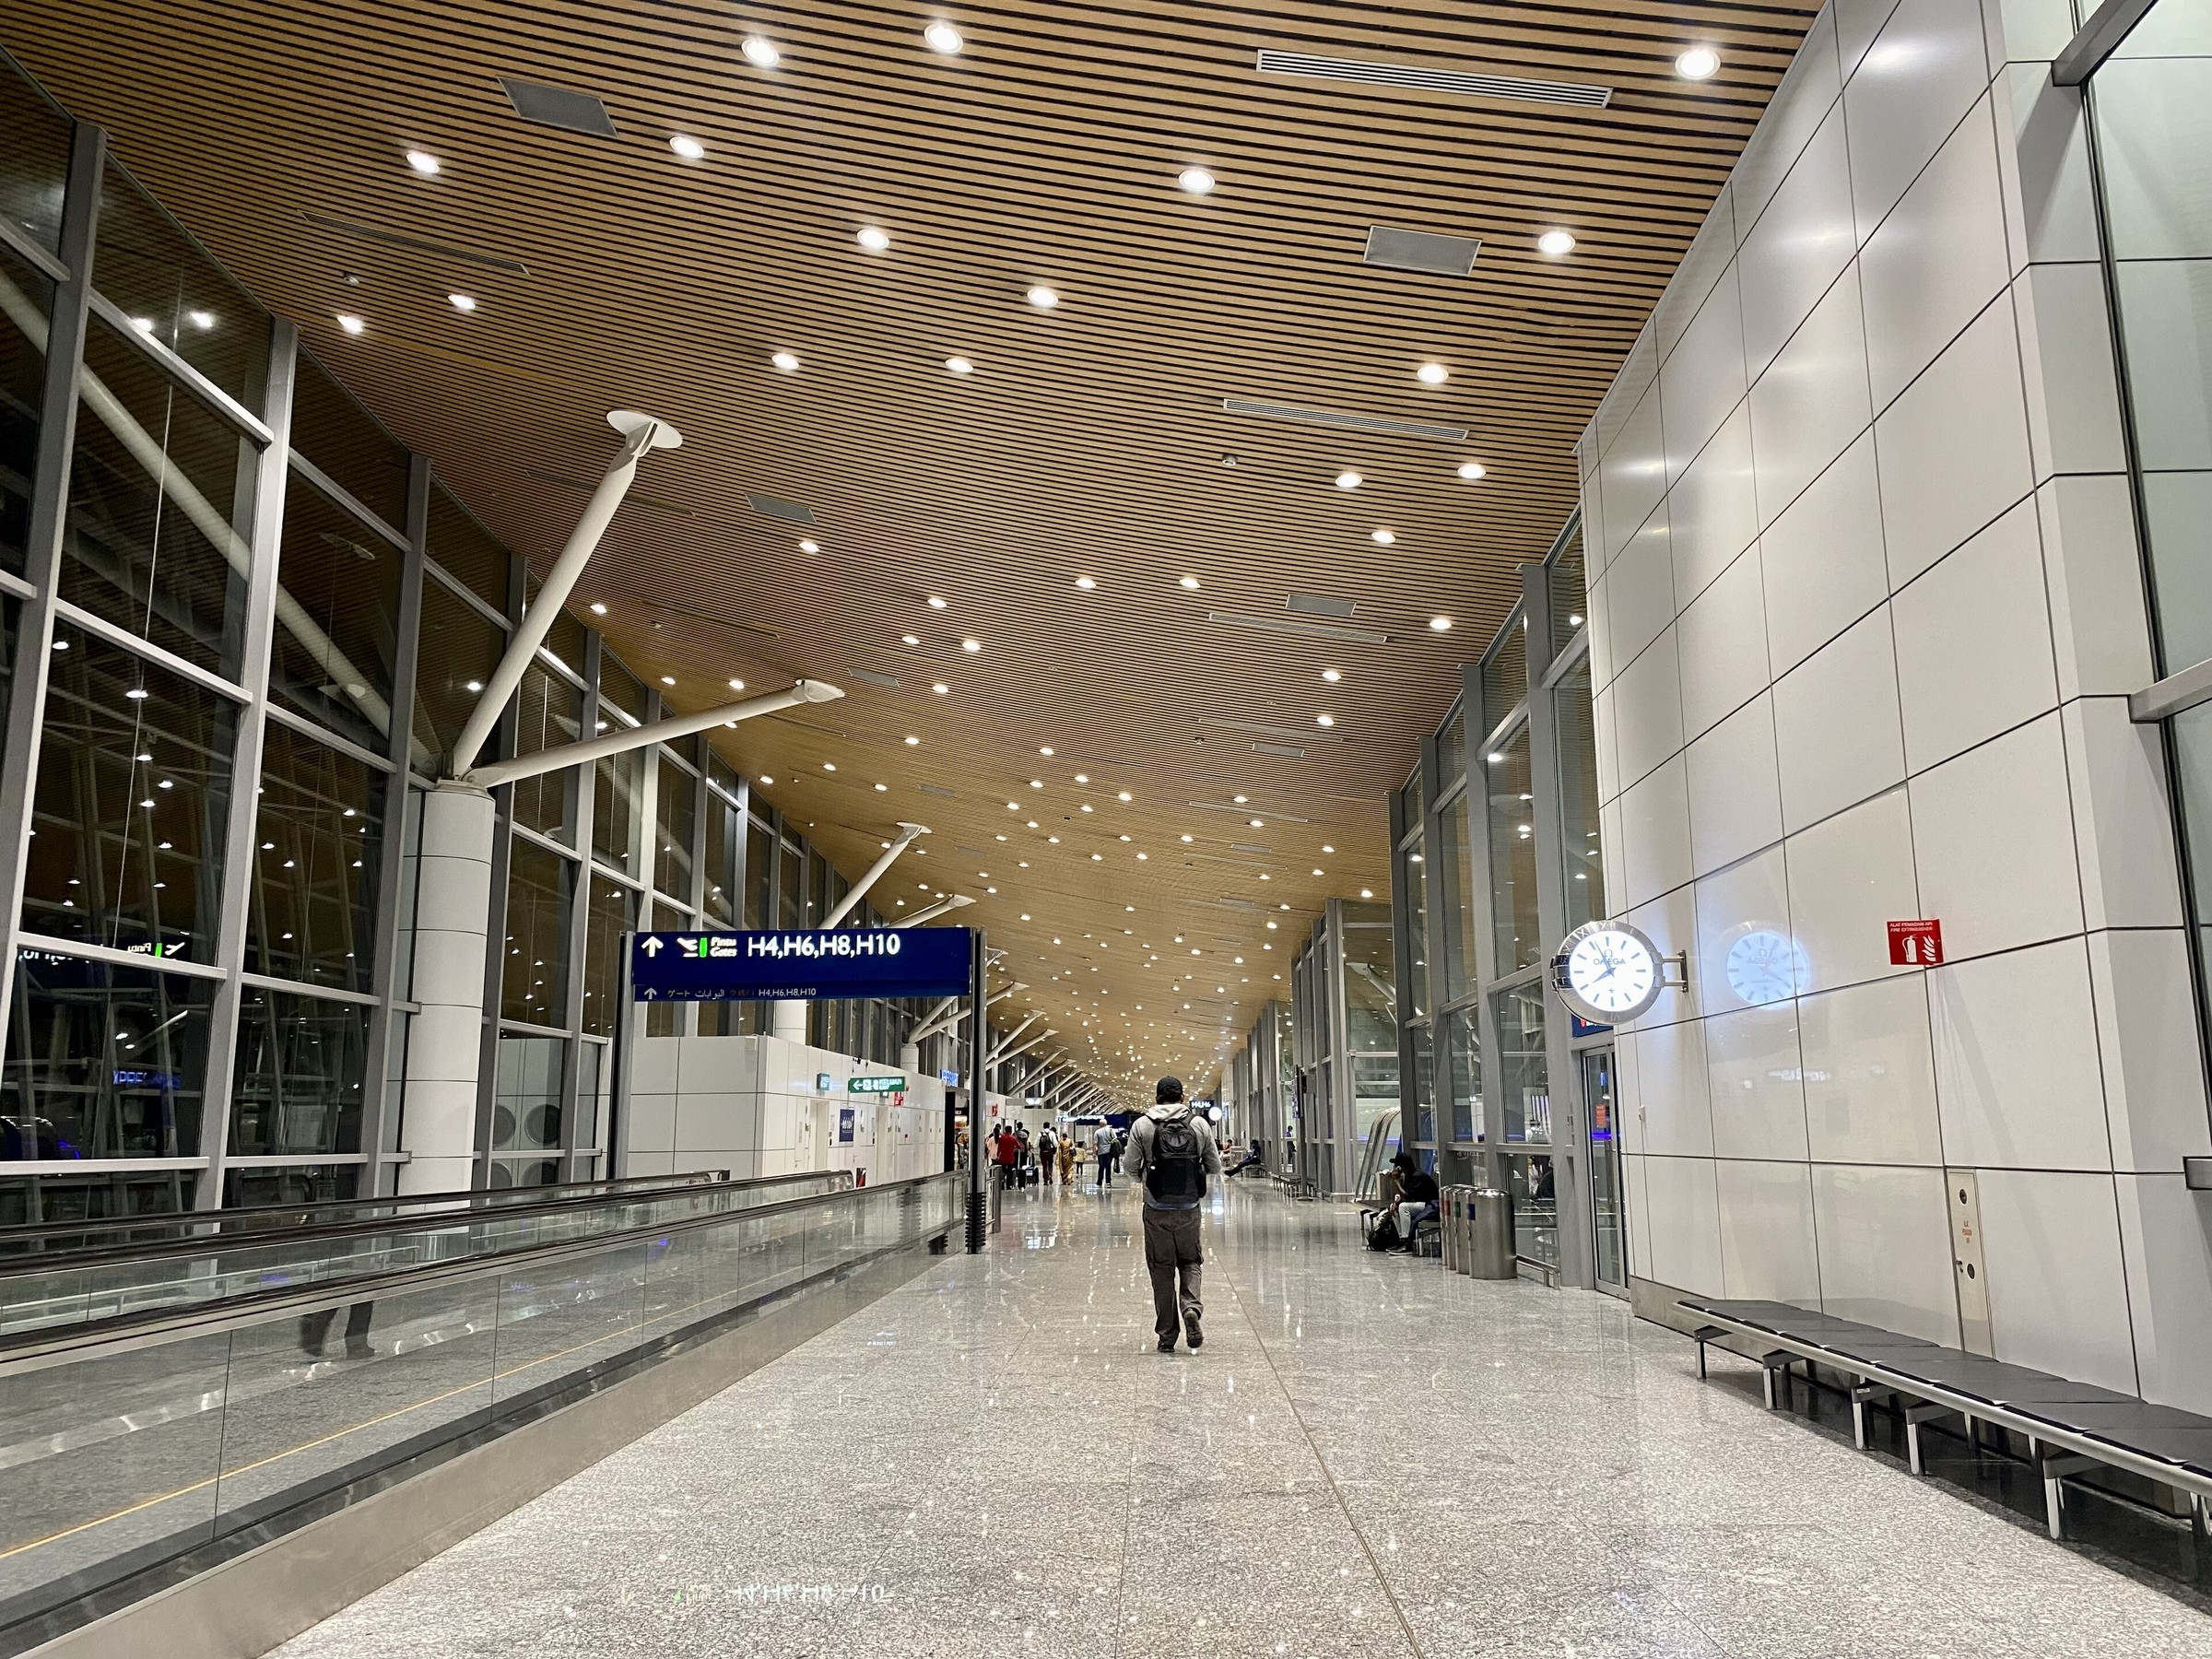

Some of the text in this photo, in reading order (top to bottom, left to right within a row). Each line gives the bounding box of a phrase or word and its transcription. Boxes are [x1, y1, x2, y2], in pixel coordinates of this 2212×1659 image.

[711, 936, 737, 947] Pintu
[747, 934, 901, 959] H4,H6,H8,H10
[711, 947, 737, 958] Gates
[667, 989, 690, 997] ゲート
[759, 988, 817, 997] H4,H6,H8,H10
